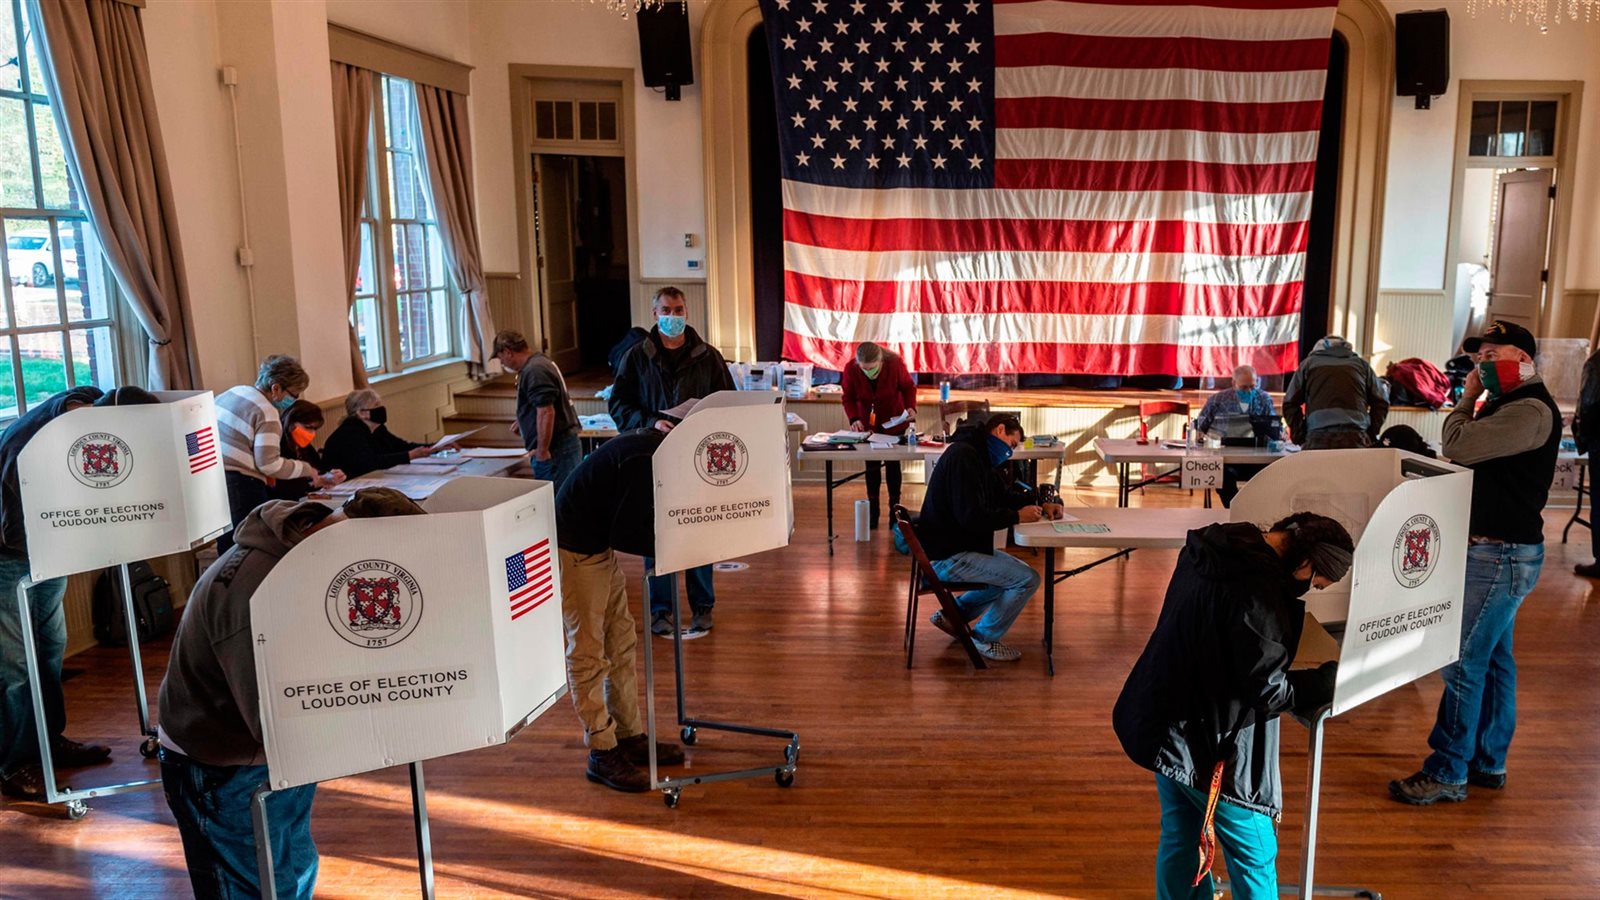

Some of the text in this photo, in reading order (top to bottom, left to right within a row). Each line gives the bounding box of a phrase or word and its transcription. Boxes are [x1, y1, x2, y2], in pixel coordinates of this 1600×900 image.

[1185, 460, 1221, 471] Check
[1190, 475, 1215, 486] In -2
[40, 502, 165, 520] OFFICE OF ELECTIONS
[668, 499, 771, 518] OFFICE OF ELECTIONS
[677, 509, 763, 525] LOUDOUN COUNTY
[52, 512, 155, 528] LOUDOUN COUNTY
[328, 561, 418, 599] LOUDOUN COUNTY VIRGINIA
[1359, 600, 1452, 633] OFFICE OF ELECTIONS
[1365, 613, 1444, 642] LOUDOUN COUNTY
[366, 638, 388, 646] 1757
[283, 669, 468, 698] OFFICE OF ELECTIONS
[301, 684, 455, 710] LOUDOUN COUNTY
